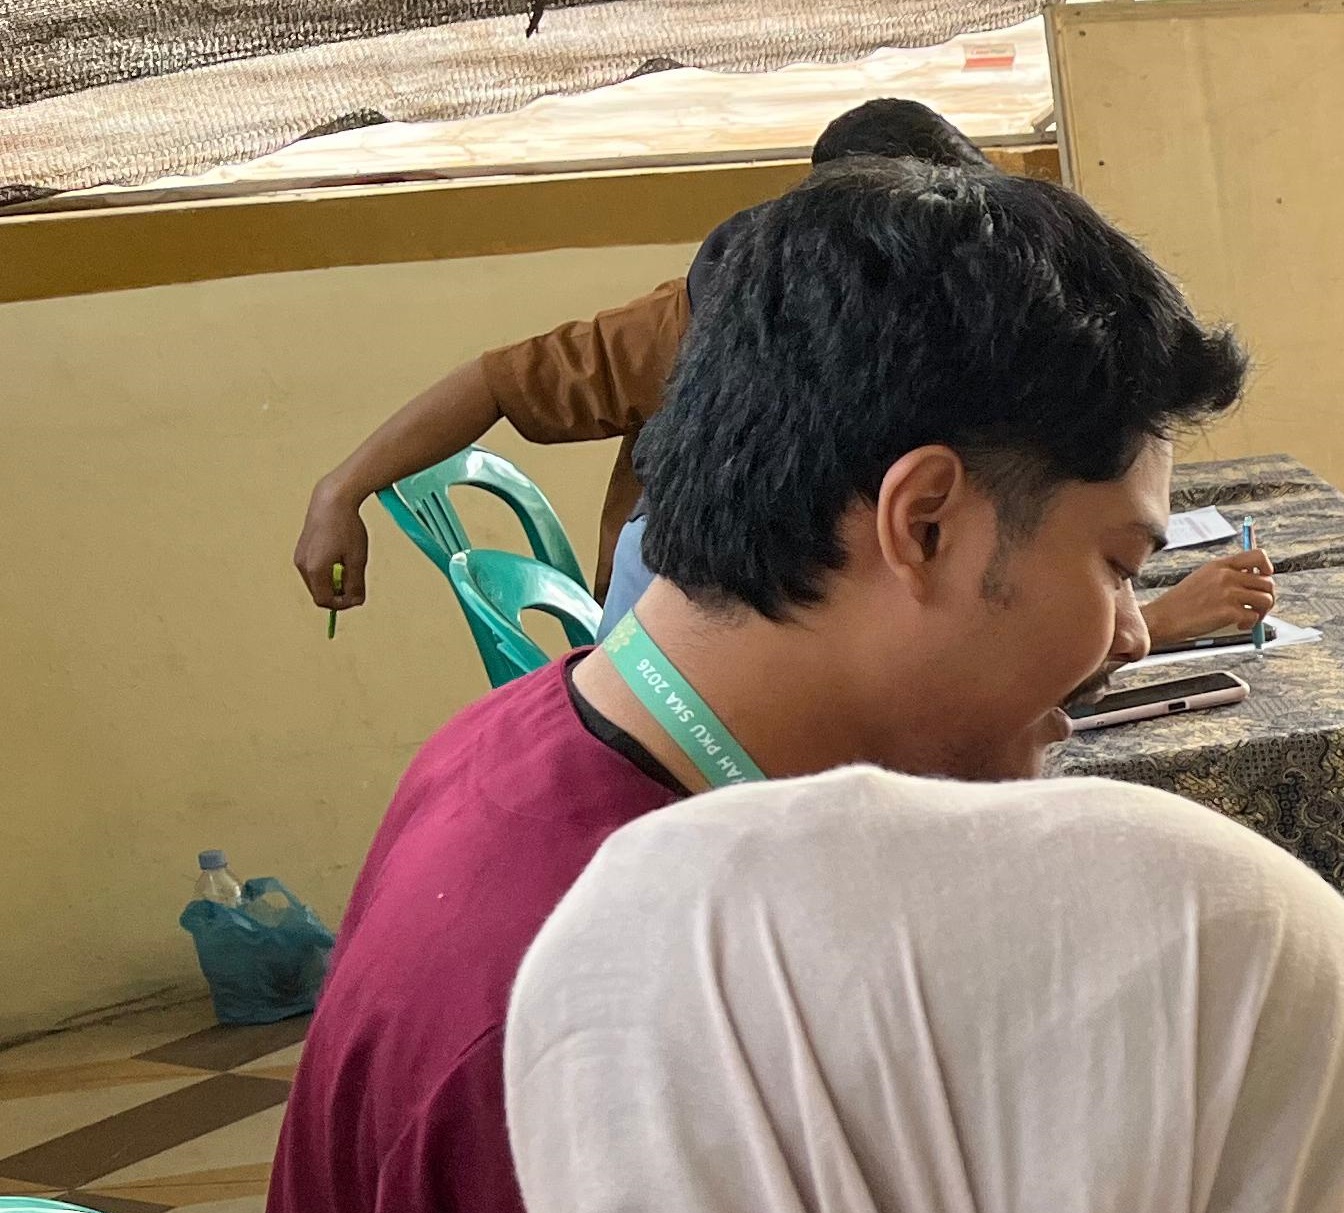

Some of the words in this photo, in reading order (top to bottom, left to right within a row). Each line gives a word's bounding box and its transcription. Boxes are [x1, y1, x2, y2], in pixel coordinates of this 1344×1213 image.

[636, 658, 671, 694] 2026
[665, 692, 695, 723] SKA
[690, 724, 722, 756] PKU
